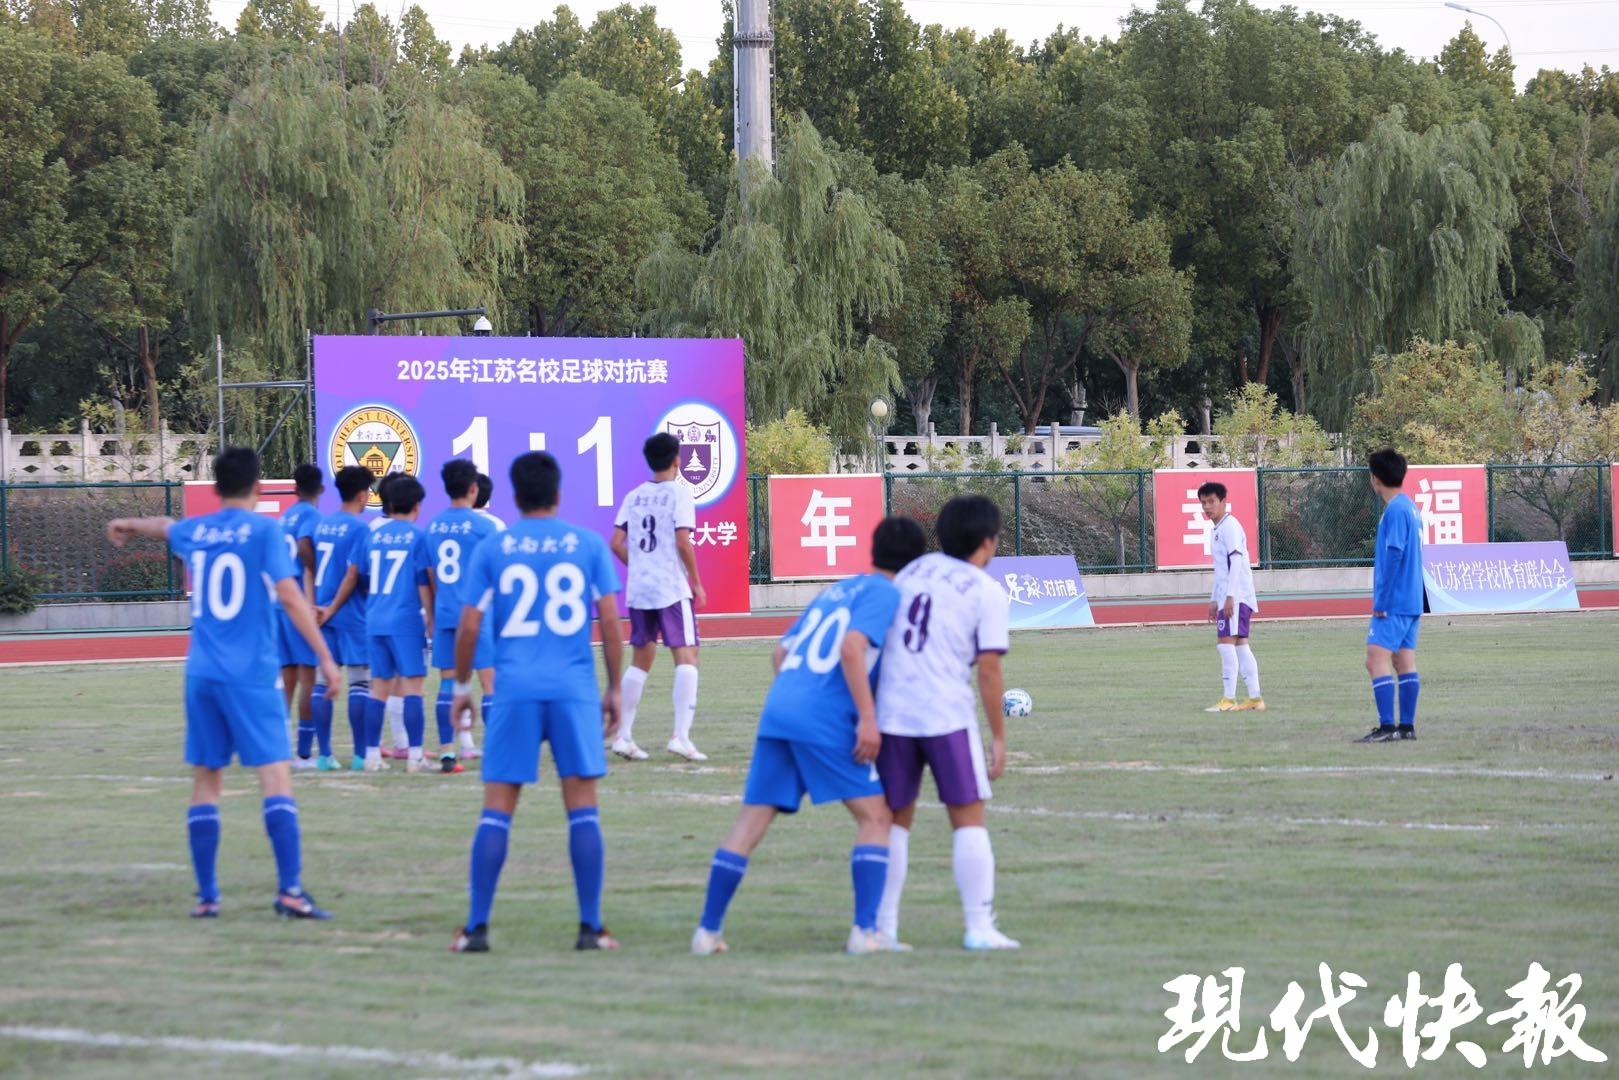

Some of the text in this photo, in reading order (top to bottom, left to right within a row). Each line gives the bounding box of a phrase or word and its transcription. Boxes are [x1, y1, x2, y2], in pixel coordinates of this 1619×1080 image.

[397, 357, 669, 384] 2025年江苏名校足球对抗赛
[334, 412, 372, 469] OUTHEAST
[640, 514, 657, 553] 3
[800, 488, 857, 567] 年
[1414, 477, 1463, 544] 福
[191, 550, 247, 621] 10
[314, 541, 335, 587] 7
[369, 549, 409, 595] 17
[436, 539, 461, 585] 8
[1430, 558, 1568, 592] 江苏省学校体育联合会
[499, 561, 588, 638] 28
[903, 591, 933, 654] 9
[779, 606, 852, 674] 20
